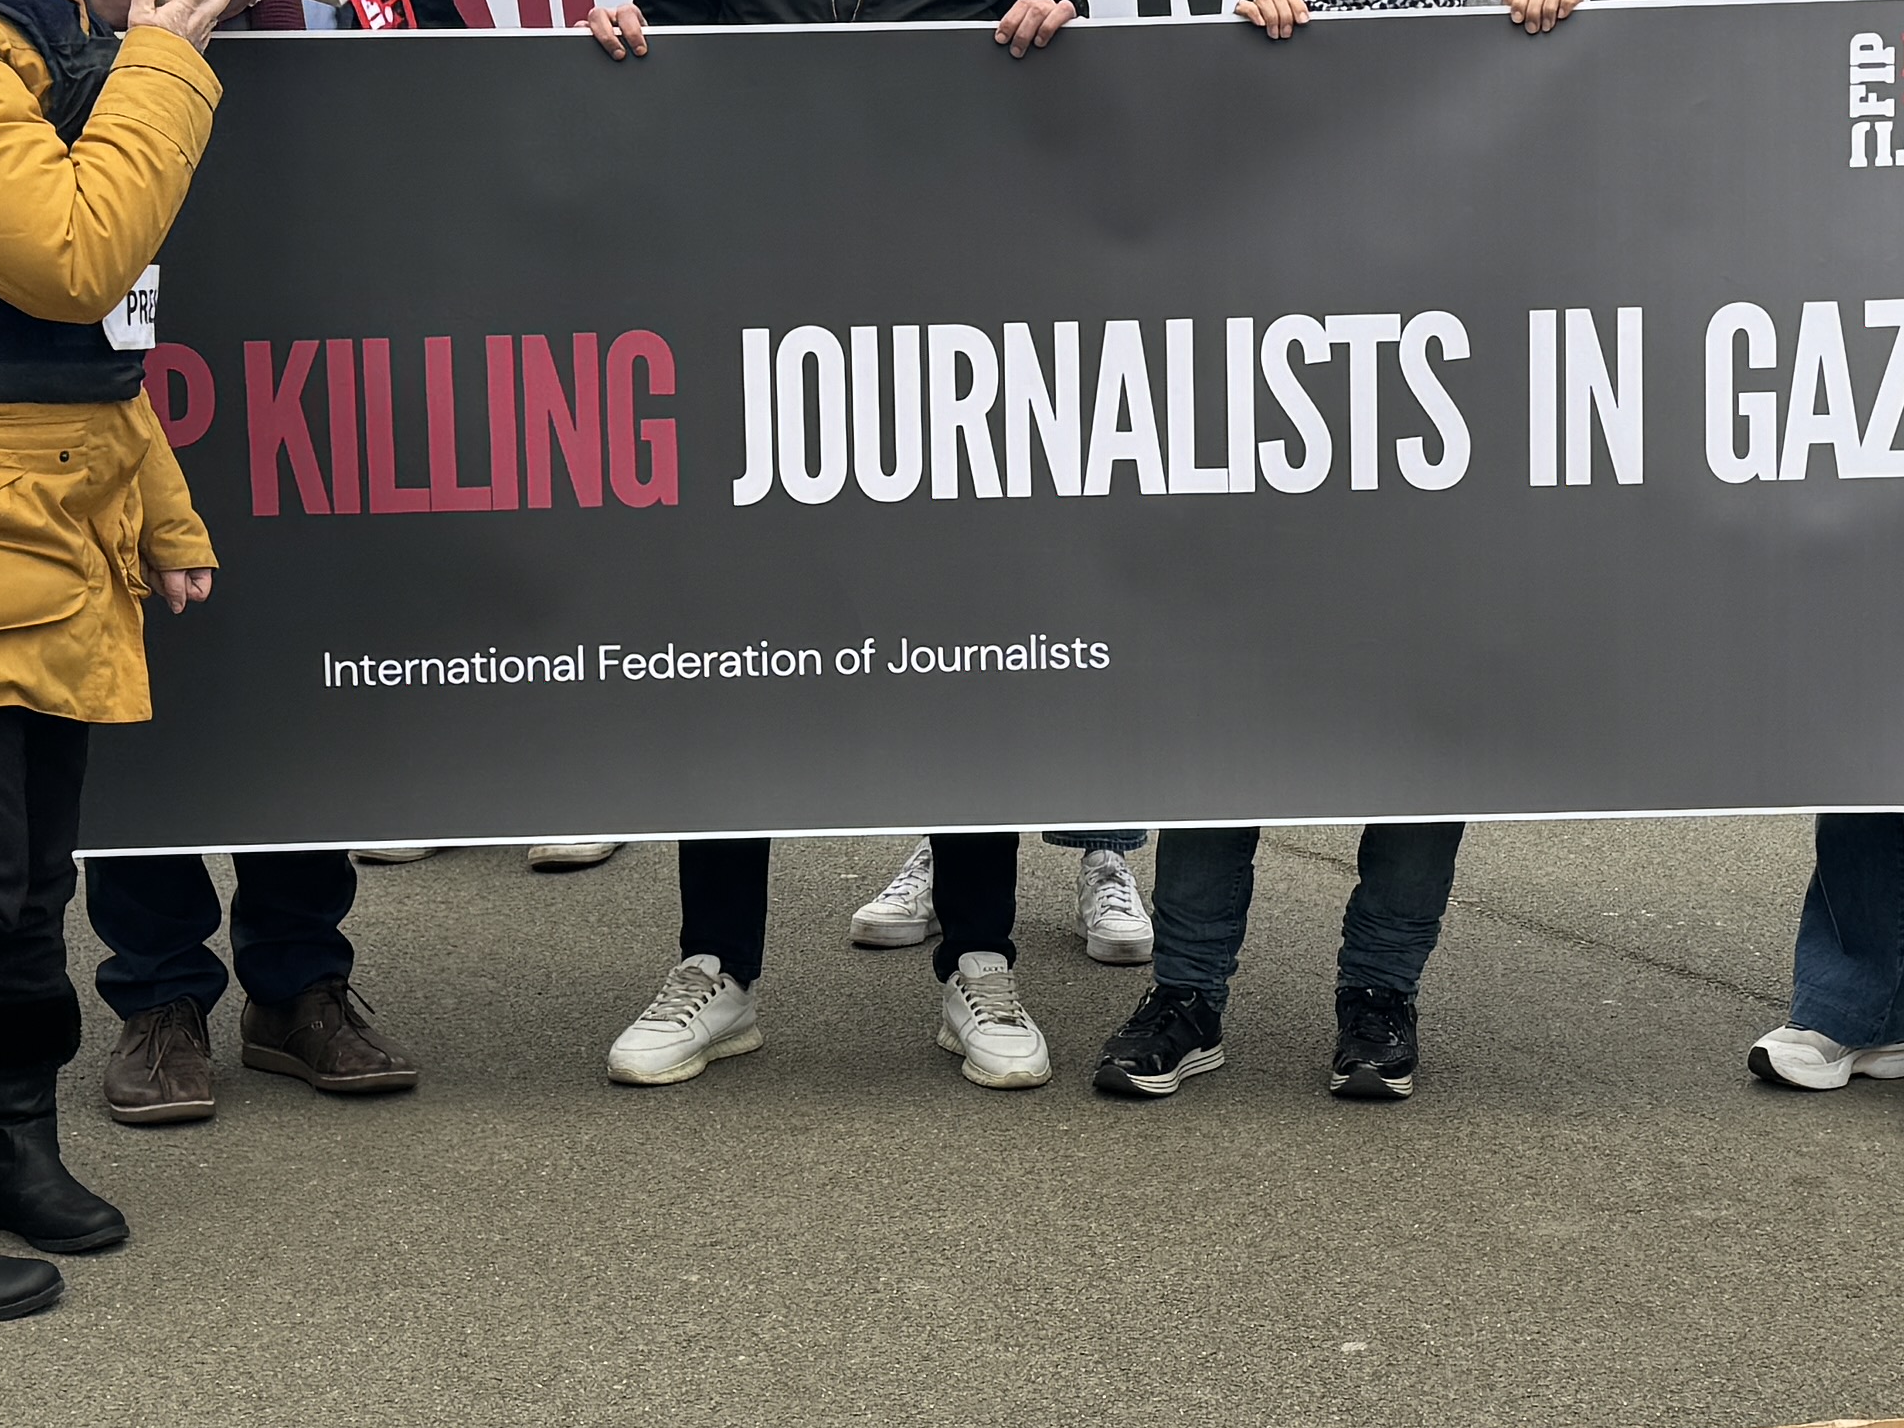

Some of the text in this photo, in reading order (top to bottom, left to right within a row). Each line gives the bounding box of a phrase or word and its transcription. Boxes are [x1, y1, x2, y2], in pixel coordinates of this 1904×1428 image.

[127, 289, 158, 325] PRE
[244, 329, 679, 517] KILLING
[732, 309, 1472, 507] JOURNALISTS
[1529, 306, 1644, 488] IN
[323, 634, 1111, 688] International Federation of Journalists
